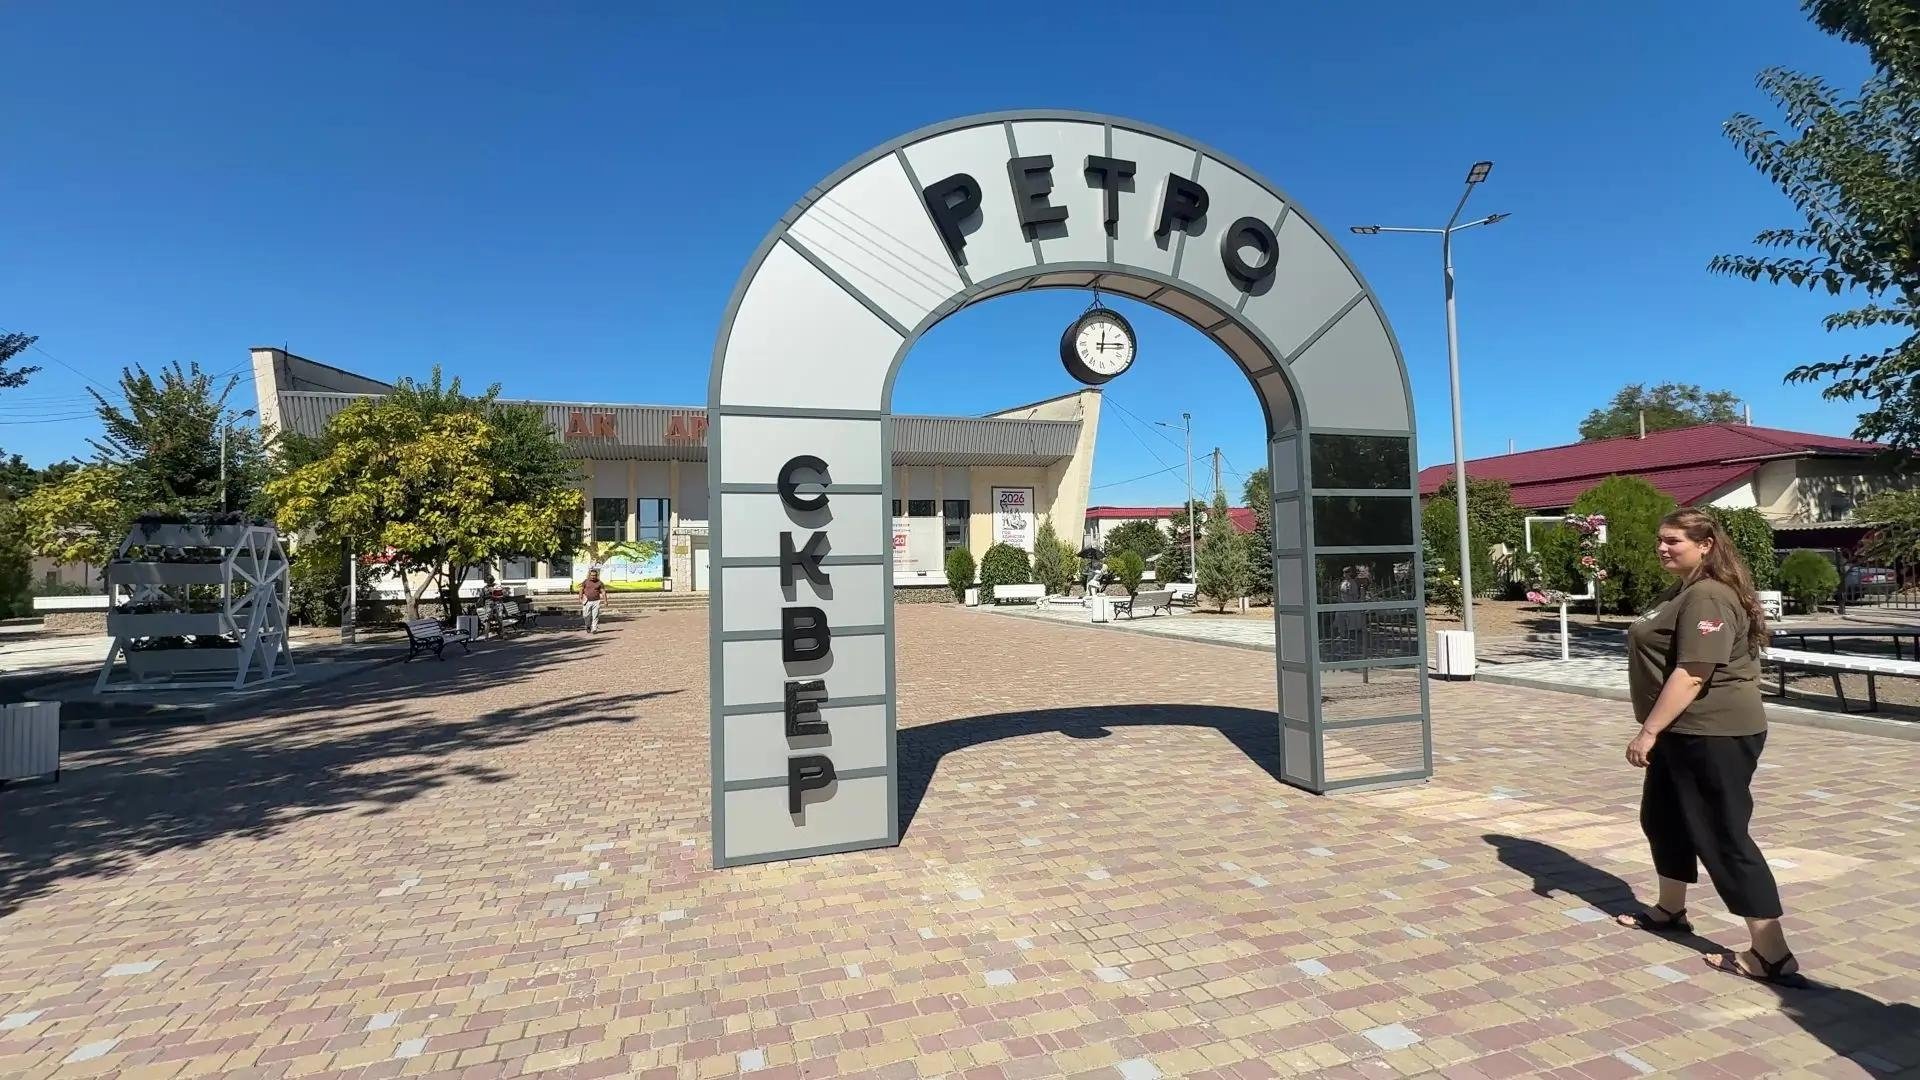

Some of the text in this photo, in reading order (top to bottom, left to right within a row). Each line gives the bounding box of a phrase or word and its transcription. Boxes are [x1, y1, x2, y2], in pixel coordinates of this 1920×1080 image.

[923, 154, 1280, 282] РЕТРО
[1001, 493, 1025, 504] 2026
[777, 454, 837, 816] СКВЕР
